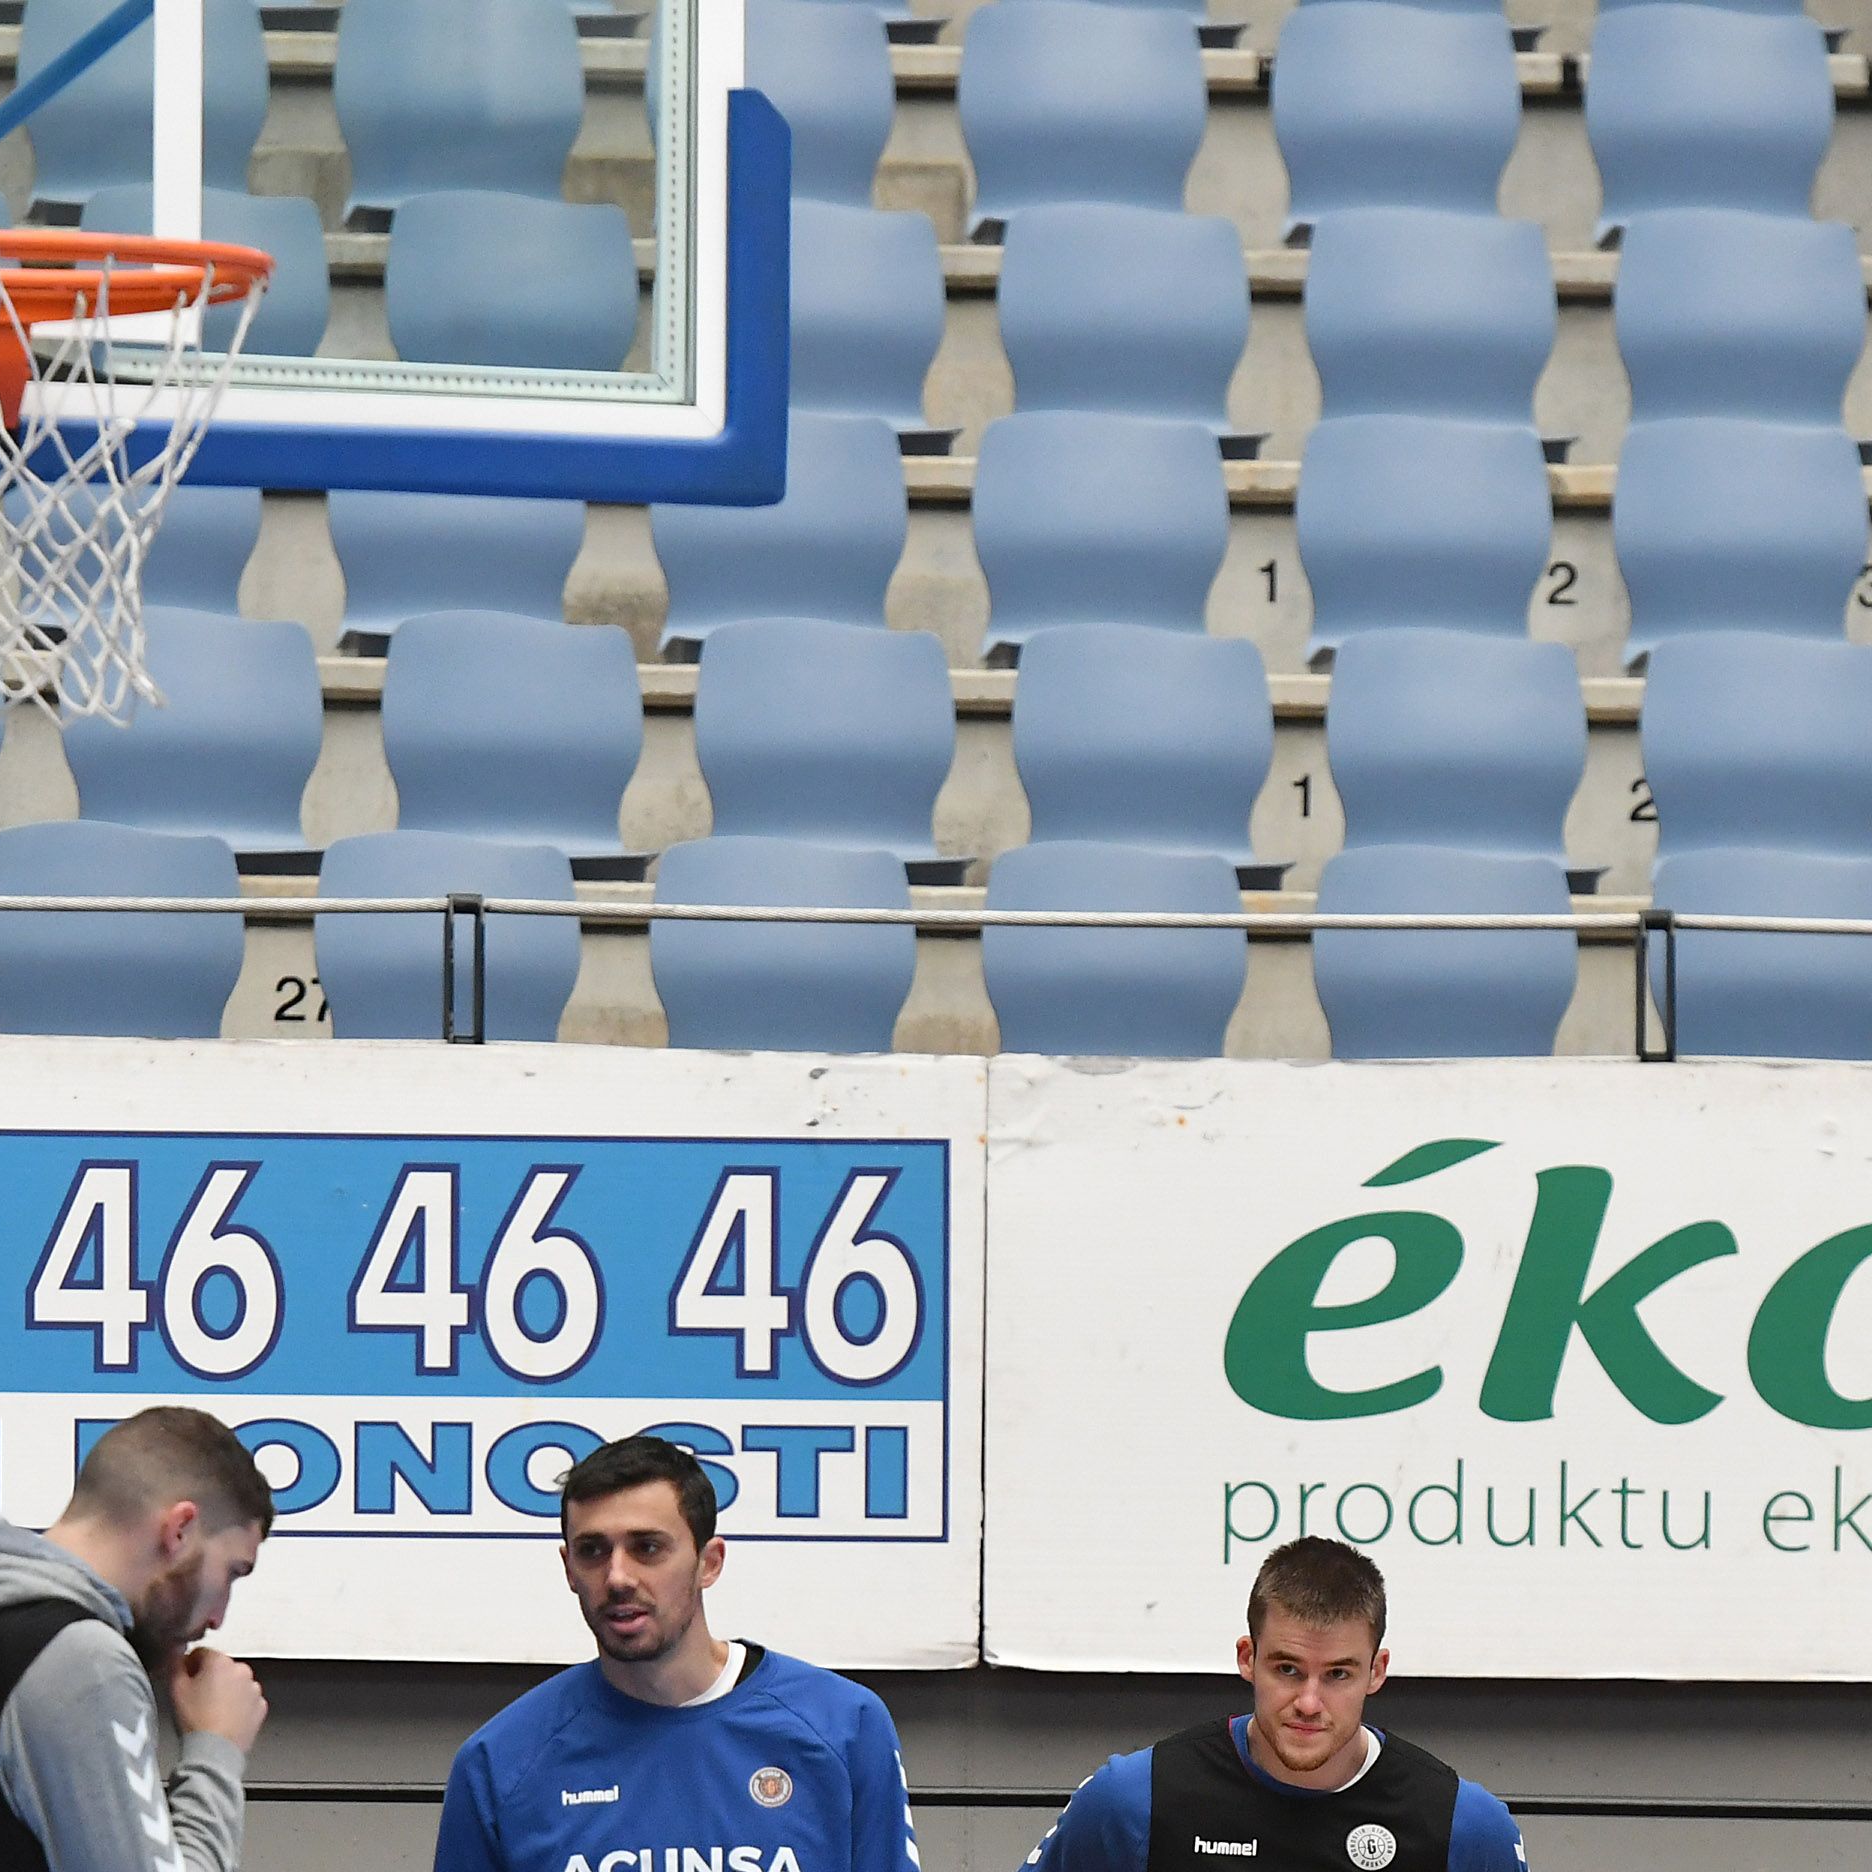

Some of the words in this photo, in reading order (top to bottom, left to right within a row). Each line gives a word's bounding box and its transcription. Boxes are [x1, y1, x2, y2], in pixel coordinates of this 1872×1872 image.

[1259, 559, 1278, 604] 1
[1546, 562, 1579, 606] 2
[1292, 773, 1310, 817] 1
[1629, 779, 1658, 822] 2
[23, 1158, 286, 1383] 46
[346, 1161, 608, 1386] 46
[666, 1164, 928, 1390] 46
[1223, 1458, 1713, 1565] produktu
[560, 1784, 620, 1807] hummel
[1193, 1835, 1259, 1858] hummel
